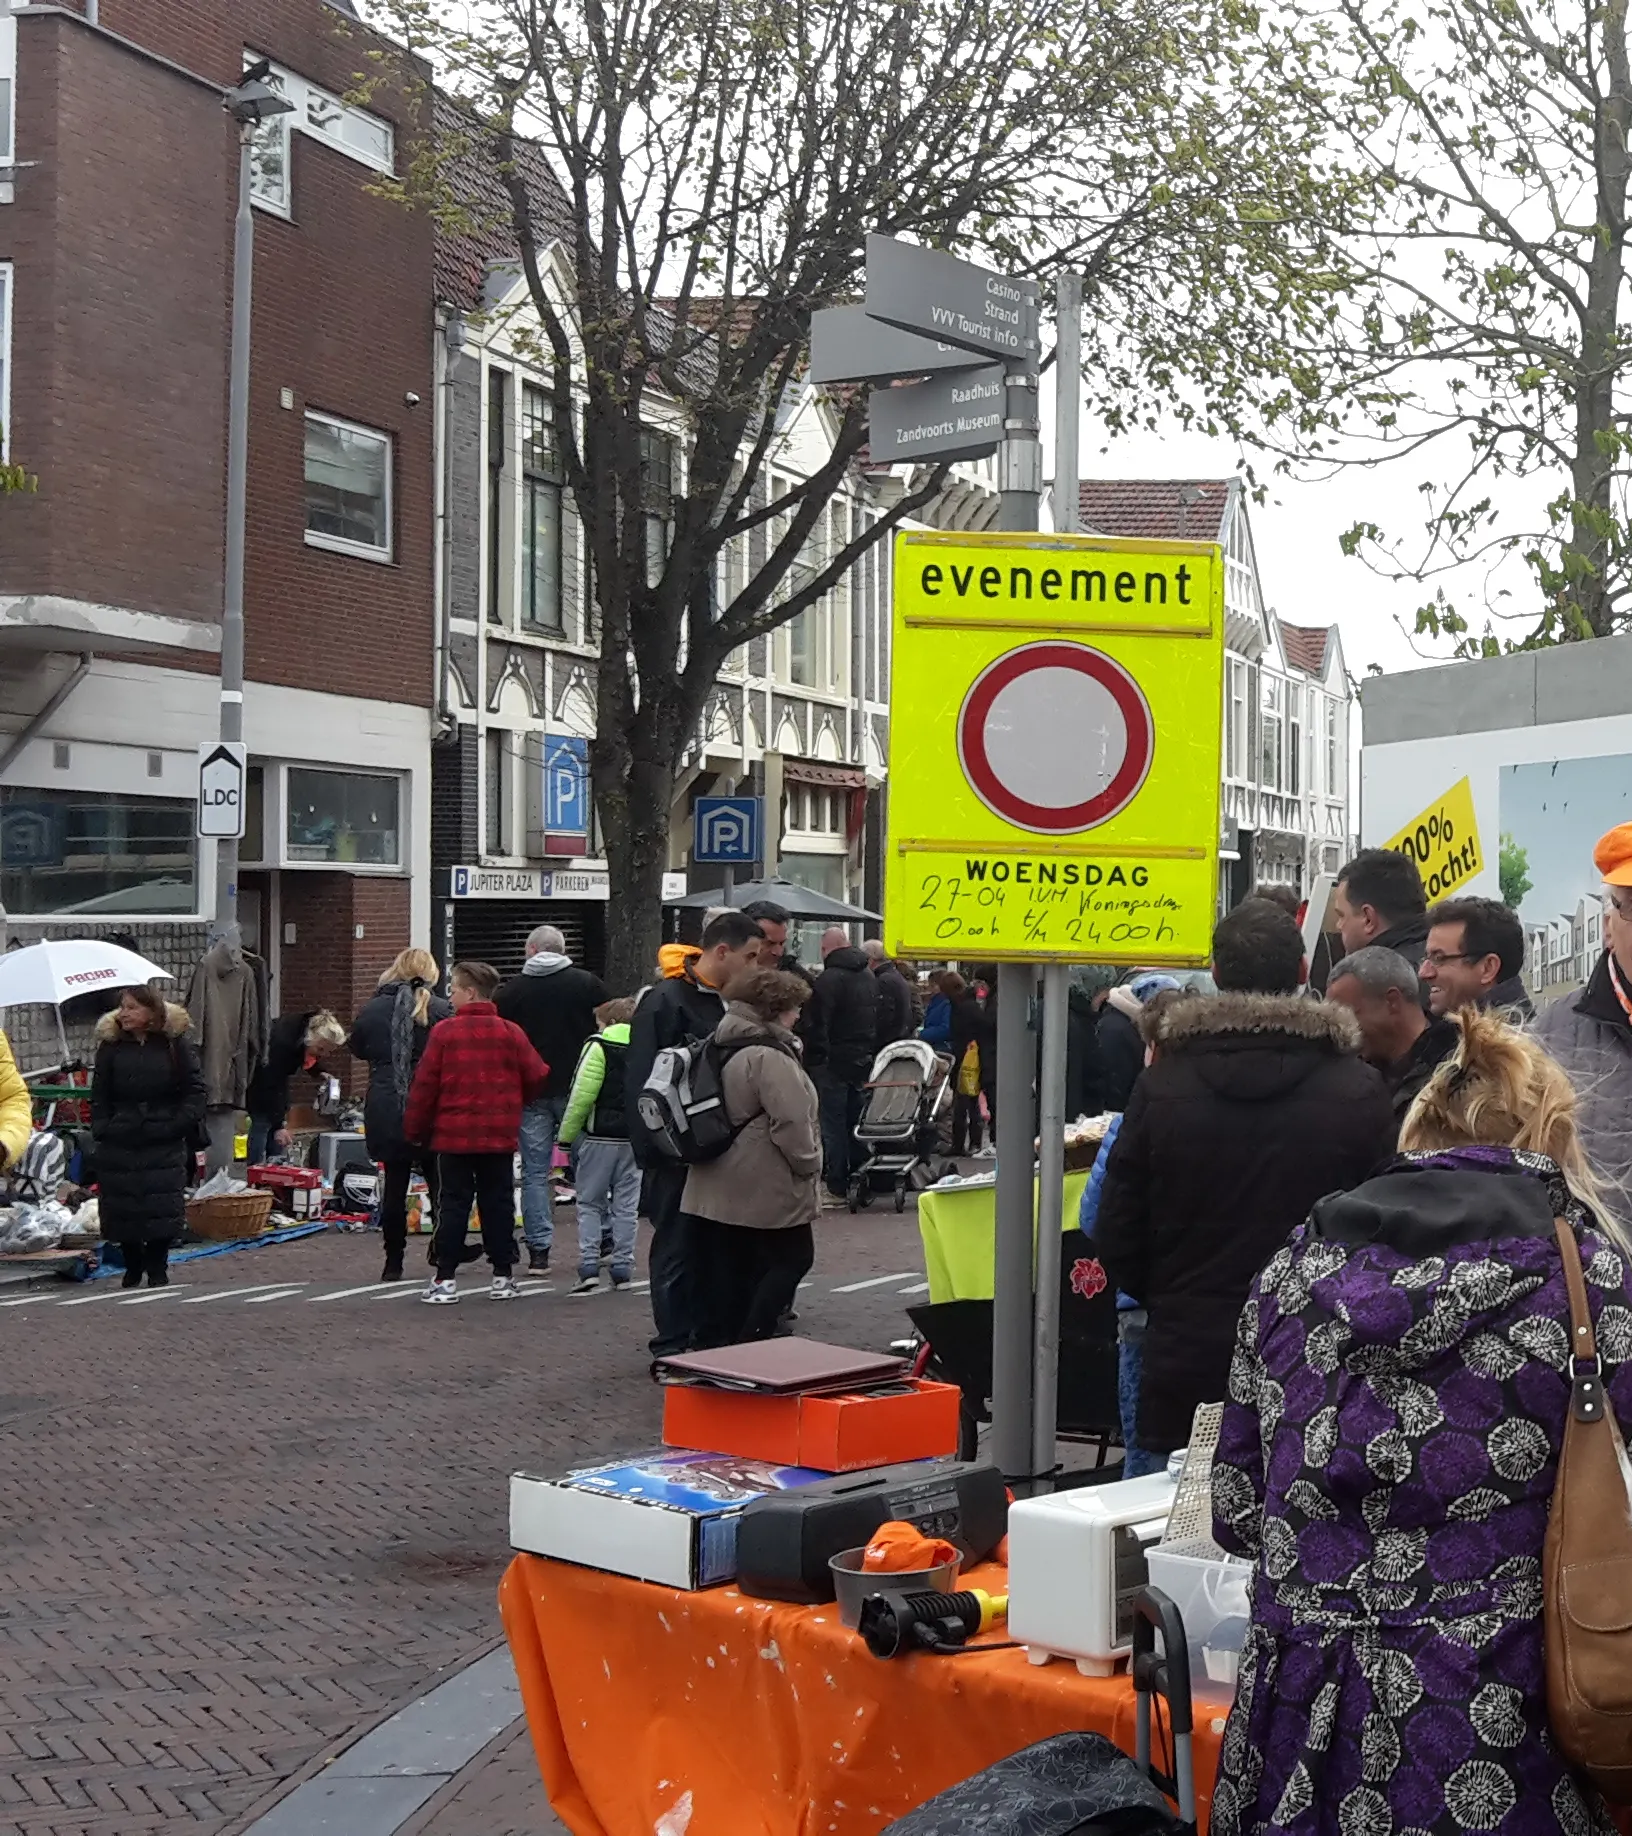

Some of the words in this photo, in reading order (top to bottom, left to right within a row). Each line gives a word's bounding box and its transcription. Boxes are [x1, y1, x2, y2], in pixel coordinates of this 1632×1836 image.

[986, 277, 1021, 302] Casino
[931, 306, 955, 327] VVV
[957, 313, 992, 340] Tourist
[994, 325, 1018, 347] info
[984, 299, 1019, 325] Strand
[951, 381, 1000, 405] Raadhuis
[896, 421, 954, 444] Zandvoorts
[956, 413, 1000, 433] Museum
[920, 563, 1192, 606] evenement
[203, 788, 238, 806] LDC
[1393, 807, 1454, 864] 00%
[470, 873, 503, 891] JUPITER
[506, 874, 533, 892] PLAZA
[555, 874, 589, 891] PARKEREN
[965, 859, 1149, 887] WOENSDAG
[1424, 835, 1477, 903] ocht!
[919, 874, 1006, 911] 27-04
[444, 902, 455, 998] WELKO
